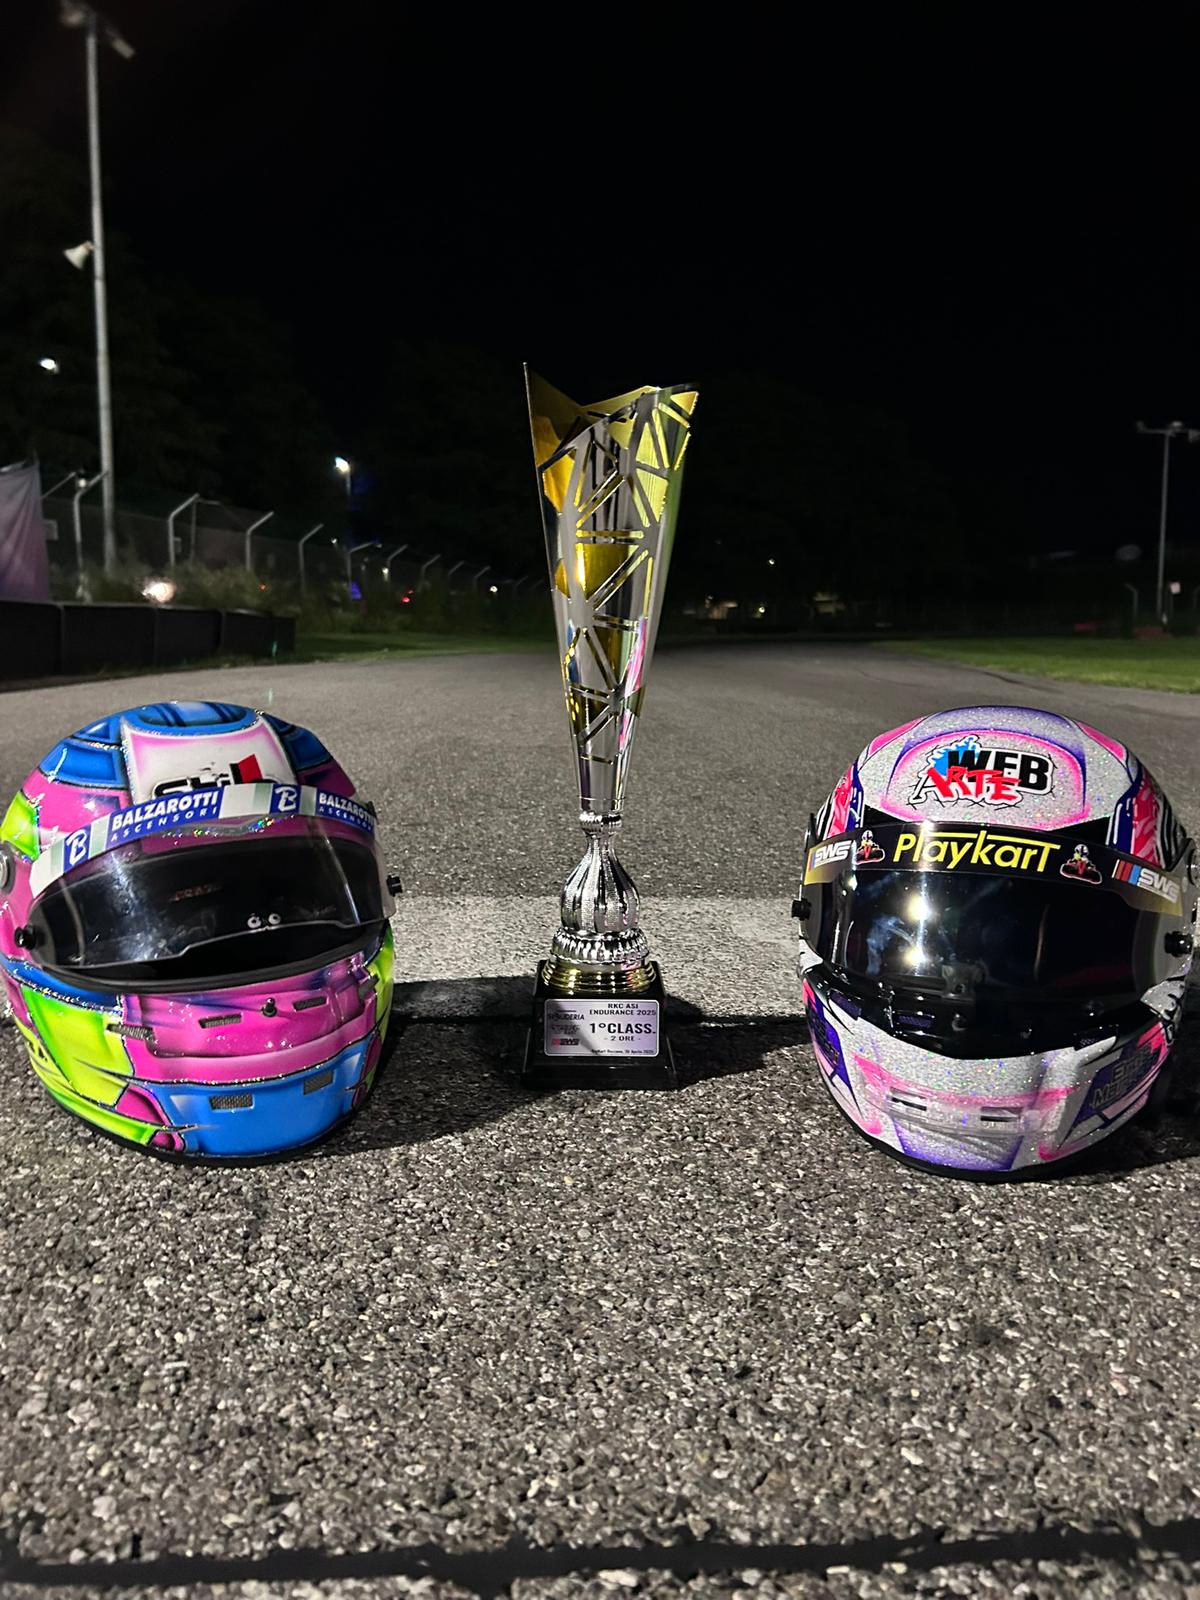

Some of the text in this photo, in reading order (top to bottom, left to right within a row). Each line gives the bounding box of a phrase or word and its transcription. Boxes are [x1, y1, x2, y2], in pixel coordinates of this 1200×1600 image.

[912, 765, 1021, 801] ARTE
[947, 750, 1050, 793] WEB
[110, 806, 218, 842] ASCENSORI
[112, 790, 219, 832] BALZAROTTI
[815, 840, 852, 861] SWS
[1138, 867, 1181, 902] SWS
[548, 1013, 585, 1021] DERIA
